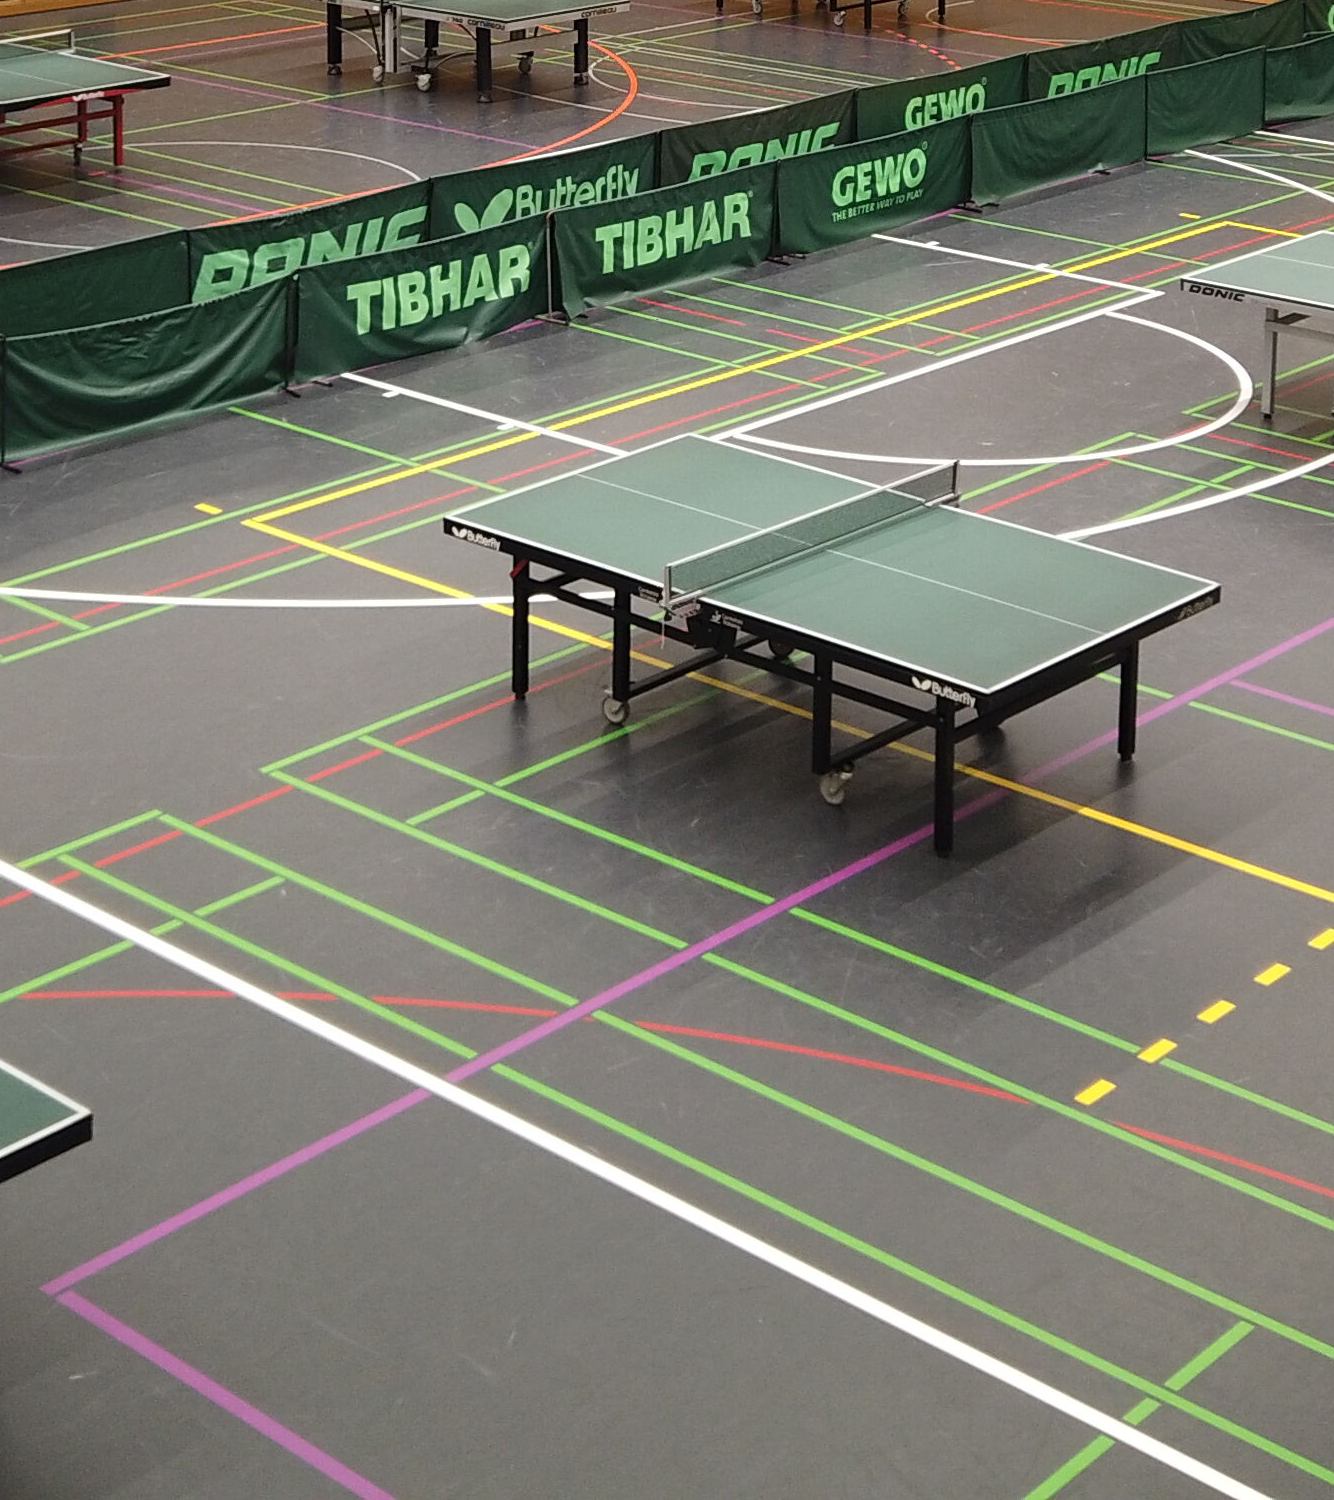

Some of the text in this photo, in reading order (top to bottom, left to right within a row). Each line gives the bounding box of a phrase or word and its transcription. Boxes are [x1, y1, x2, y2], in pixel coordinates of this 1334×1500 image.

[905, 83, 986, 131] GEWO
[832, 148, 927, 207] GEWO
[832, 188, 924, 222] THE BETTER WAY TO PLAY
[595, 192, 752, 274] TIBHAR
[346, 244, 531, 335] TIBHAR
[1189, 284, 1245, 302] DONIC
[932, 681, 976, 708] Butterfly
